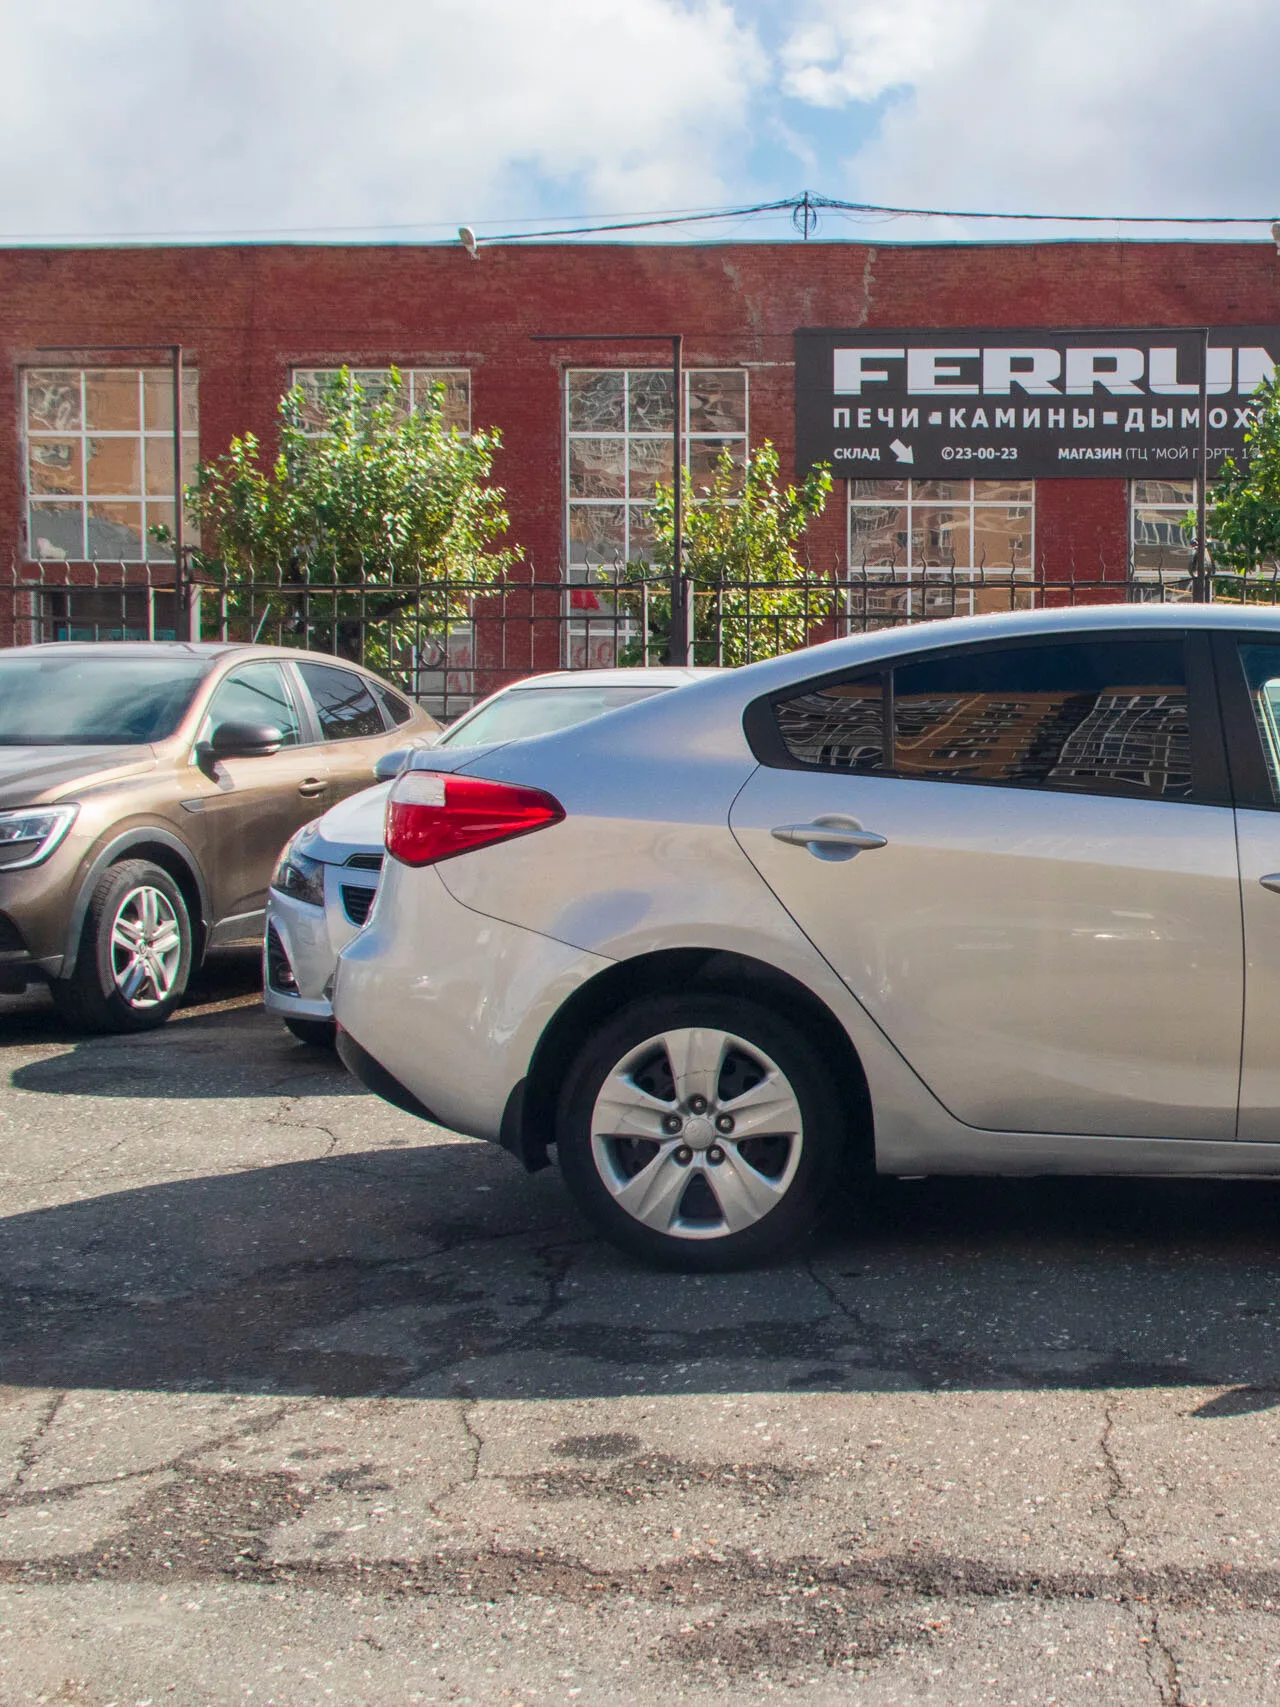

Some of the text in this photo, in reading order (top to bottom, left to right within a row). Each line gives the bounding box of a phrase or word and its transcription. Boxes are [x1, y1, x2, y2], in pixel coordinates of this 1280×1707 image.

[833, 408, 919, 428] ПЕЧИ
[949, 408, 1095, 428] КАМИНЫ
[833, 447, 880, 461] СКЛАД
[1058, 447, 1122, 460] МАГАЗИН
[1125, 447, 1148, 462] (ТЦ
